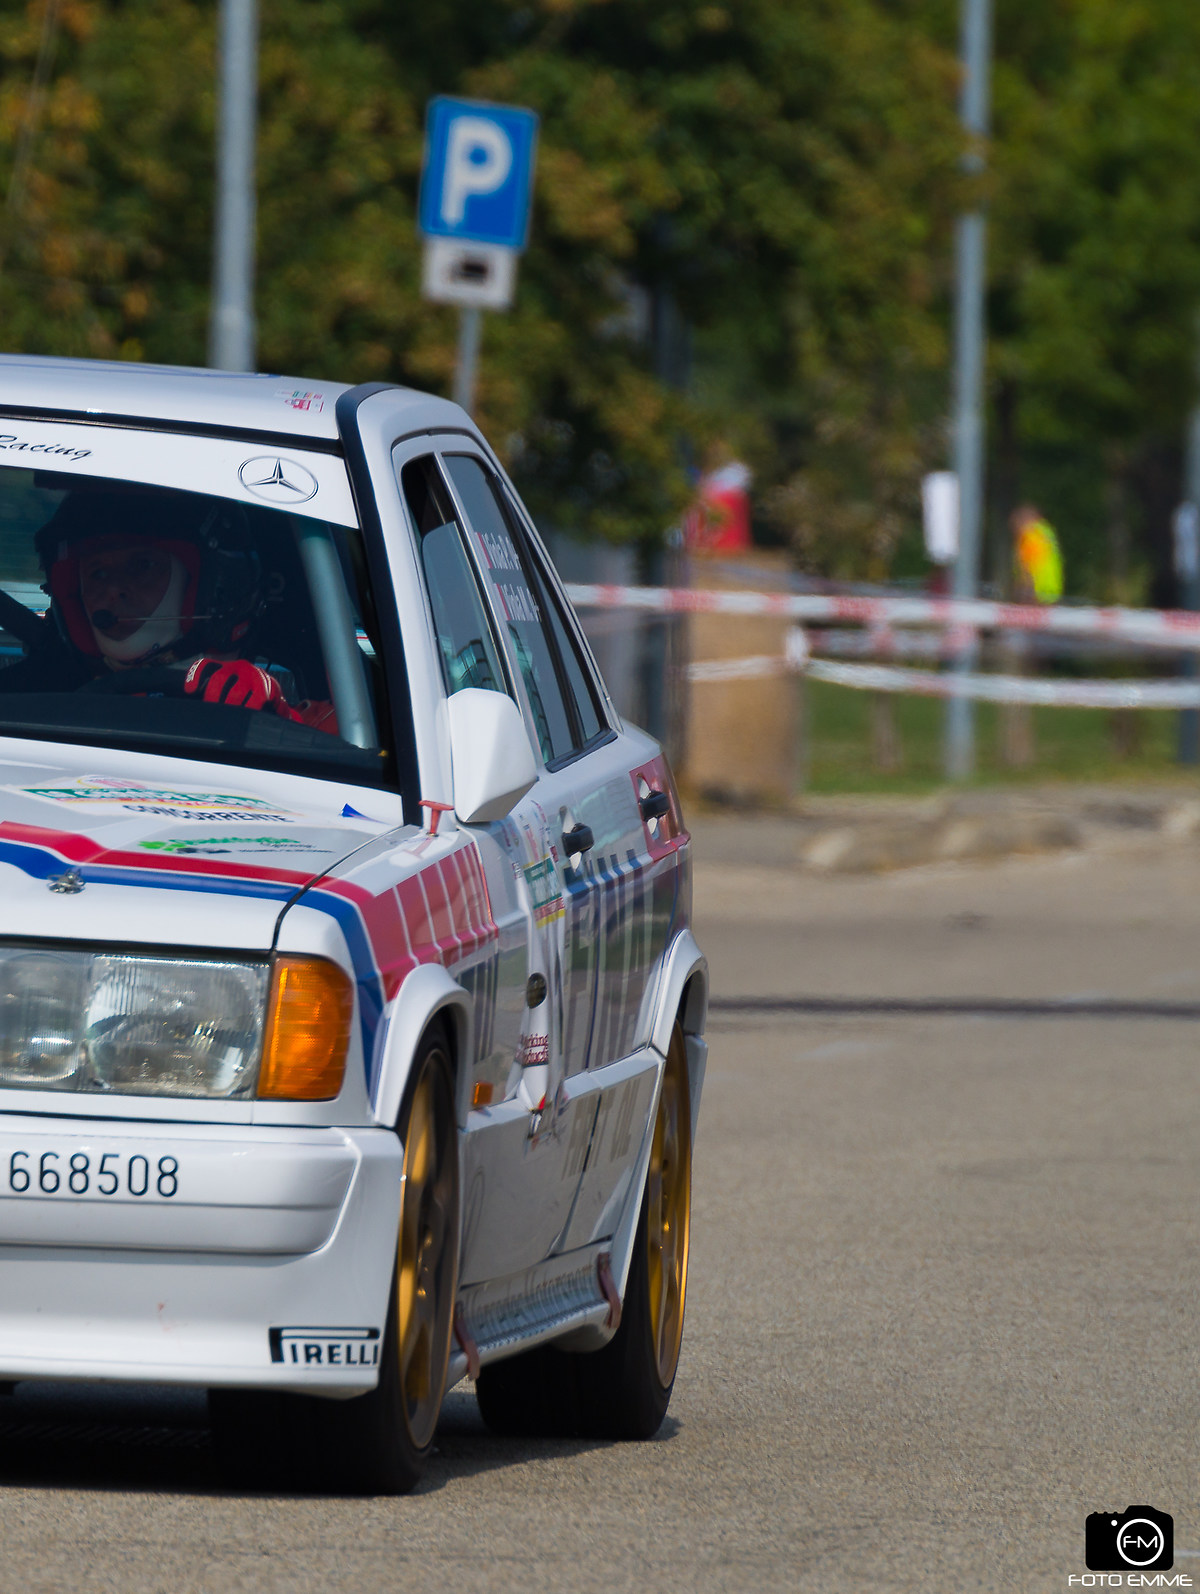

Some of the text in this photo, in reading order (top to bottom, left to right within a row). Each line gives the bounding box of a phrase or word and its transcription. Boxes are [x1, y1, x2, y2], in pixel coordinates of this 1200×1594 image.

[440, 115, 513, 227] P
[8, 1151, 180, 1198] 668508
[269, 1326, 380, 1365] PIRELLI
